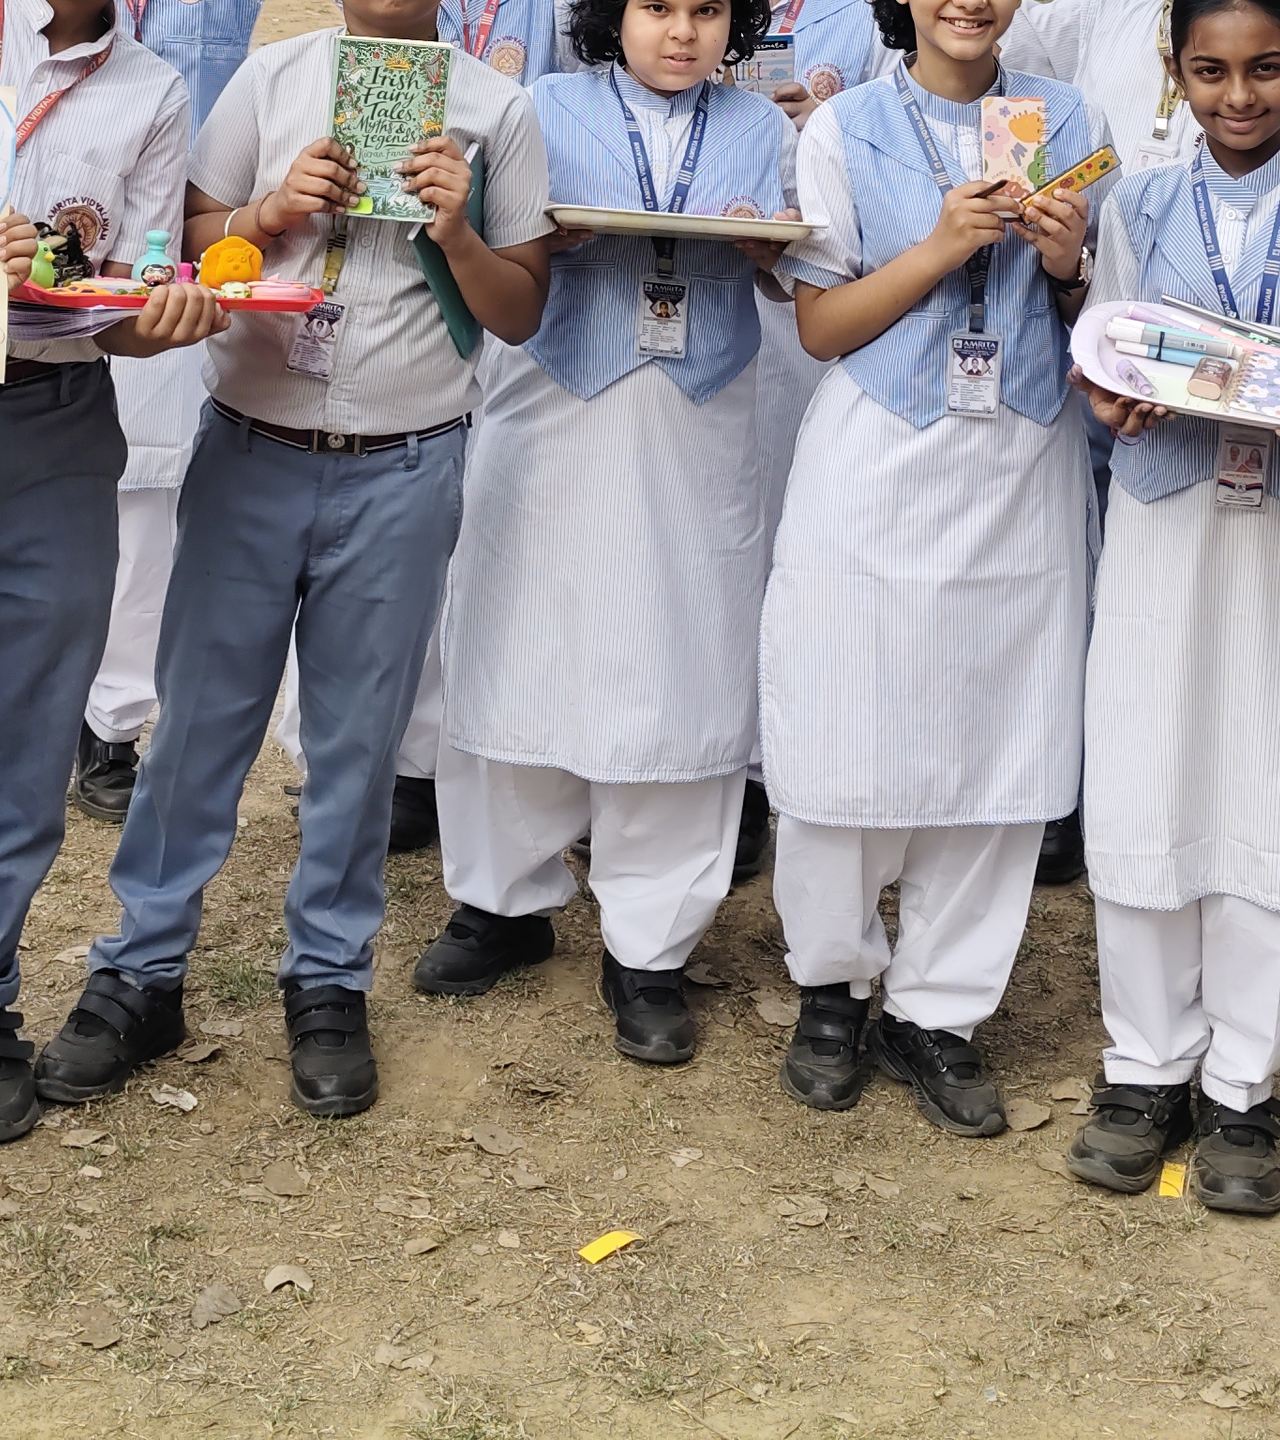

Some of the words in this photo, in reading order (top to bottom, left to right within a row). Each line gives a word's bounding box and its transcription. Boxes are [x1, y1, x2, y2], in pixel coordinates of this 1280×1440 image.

[371, 66, 421, 90] Irish
[362, 86, 419, 109] Fairy
[354, 115, 393, 139] Myths
[395, 123, 405, 134] &
[363, 131, 418, 149] Legends
[47, 196, 78, 221] AMRITA
[80, 196, 110, 241] VIDYALAYAM
[1203, 224, 1214, 245] AMRITA
[653, 284, 683, 293] AMRITA
[963, 340, 995, 348] AMRITA
